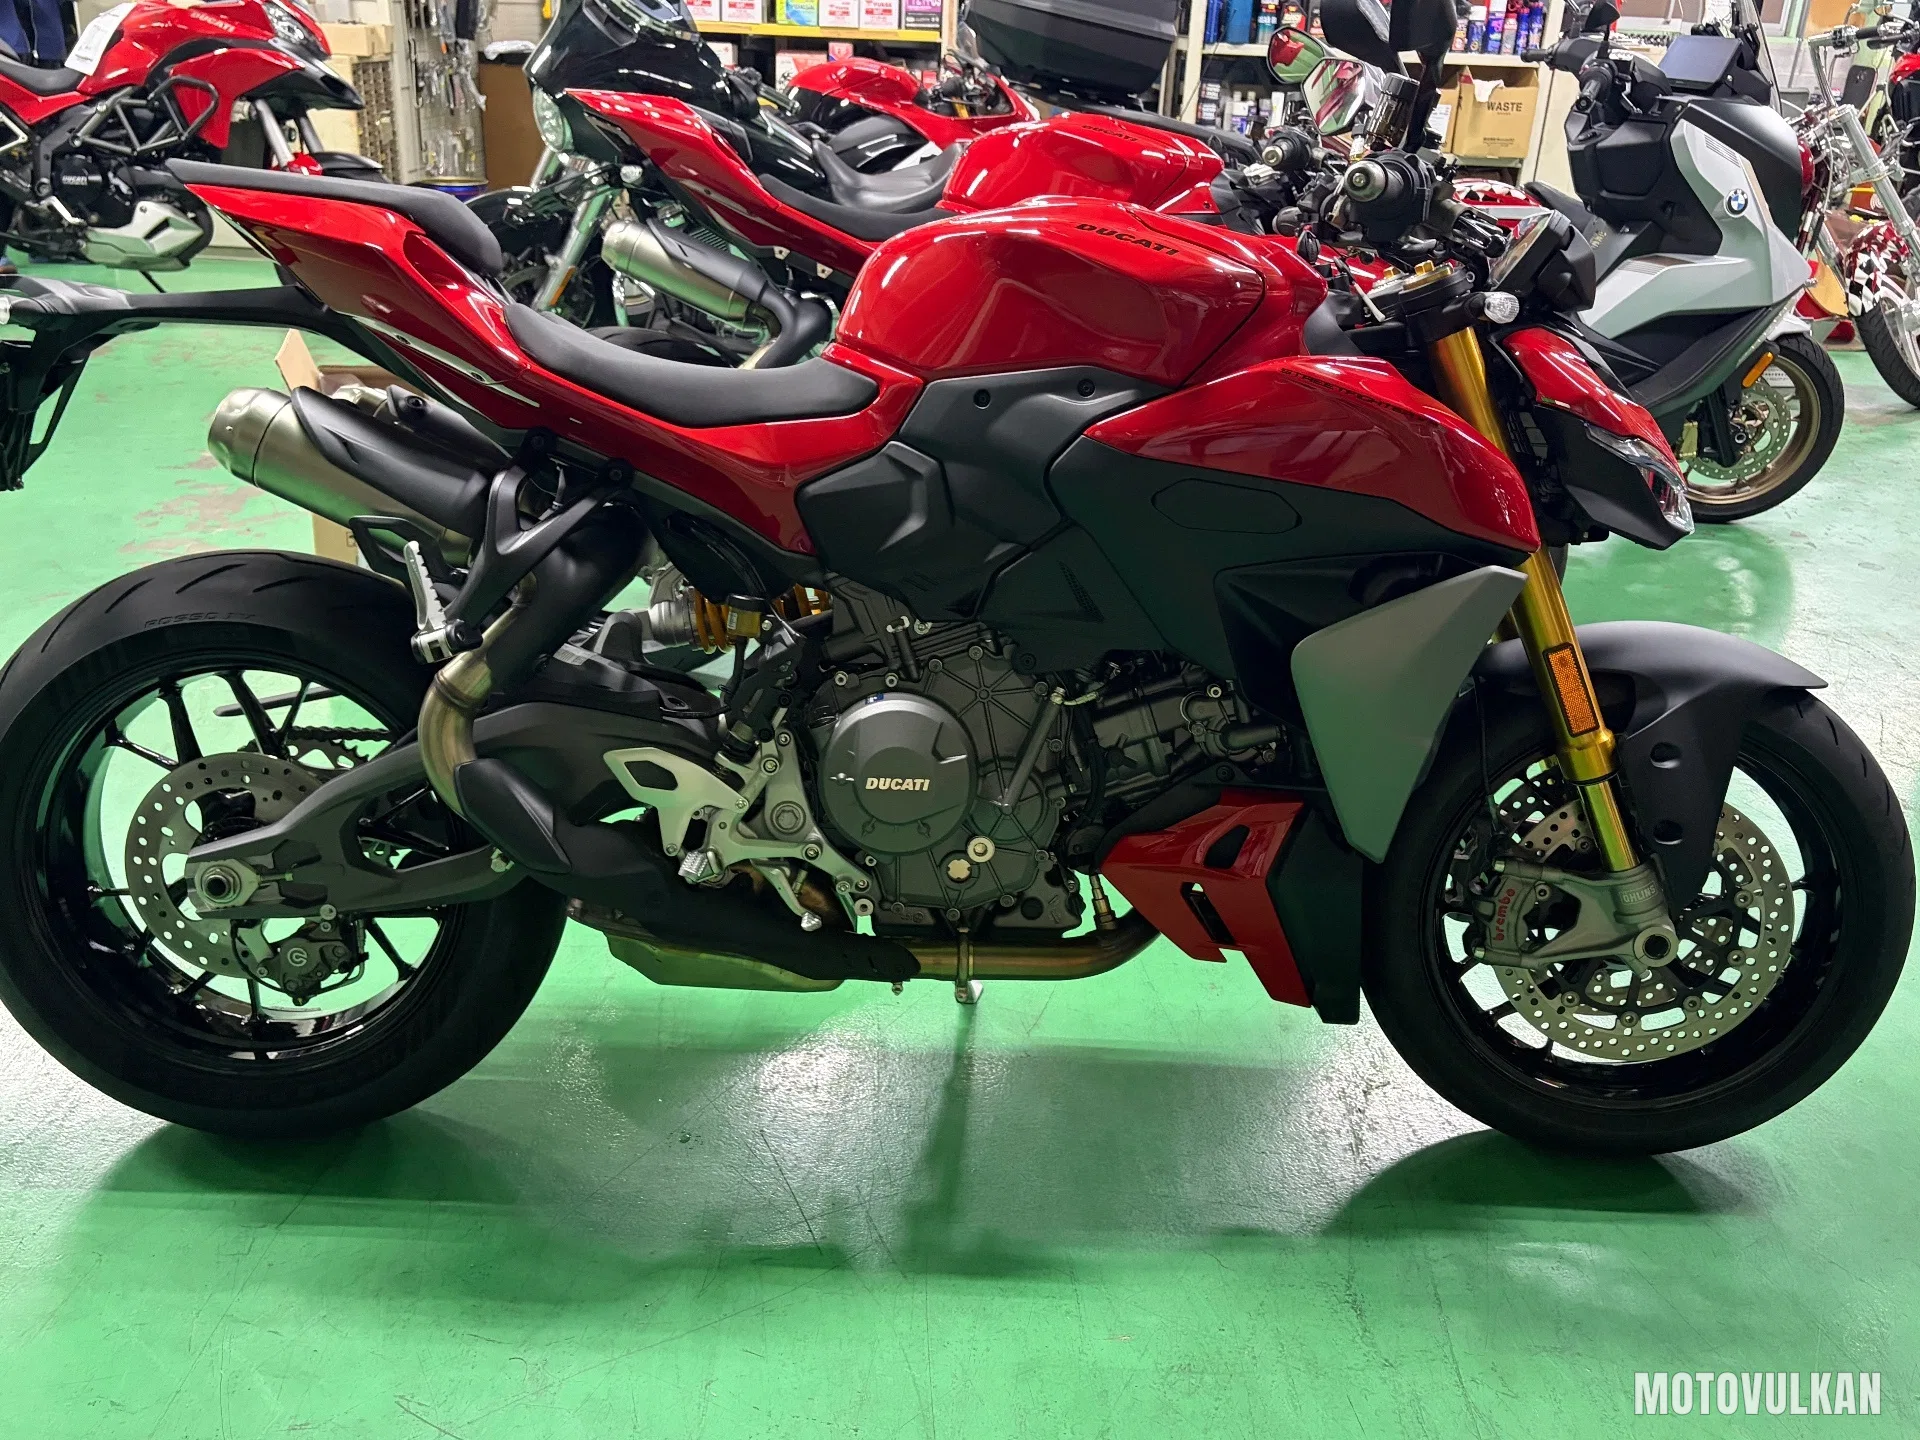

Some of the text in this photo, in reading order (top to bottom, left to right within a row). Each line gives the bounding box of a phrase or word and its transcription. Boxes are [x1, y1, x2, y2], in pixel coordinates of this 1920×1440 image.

[190, 11, 236, 32] DUCATI
[1487, 101, 1522, 112] WASTE
[1076, 224, 1179, 255] DUCATI
[865, 777, 930, 791] DUCATI
[1623, 881, 1656, 904] ÖHLINS
[1493, 888, 1516, 941] brembo
